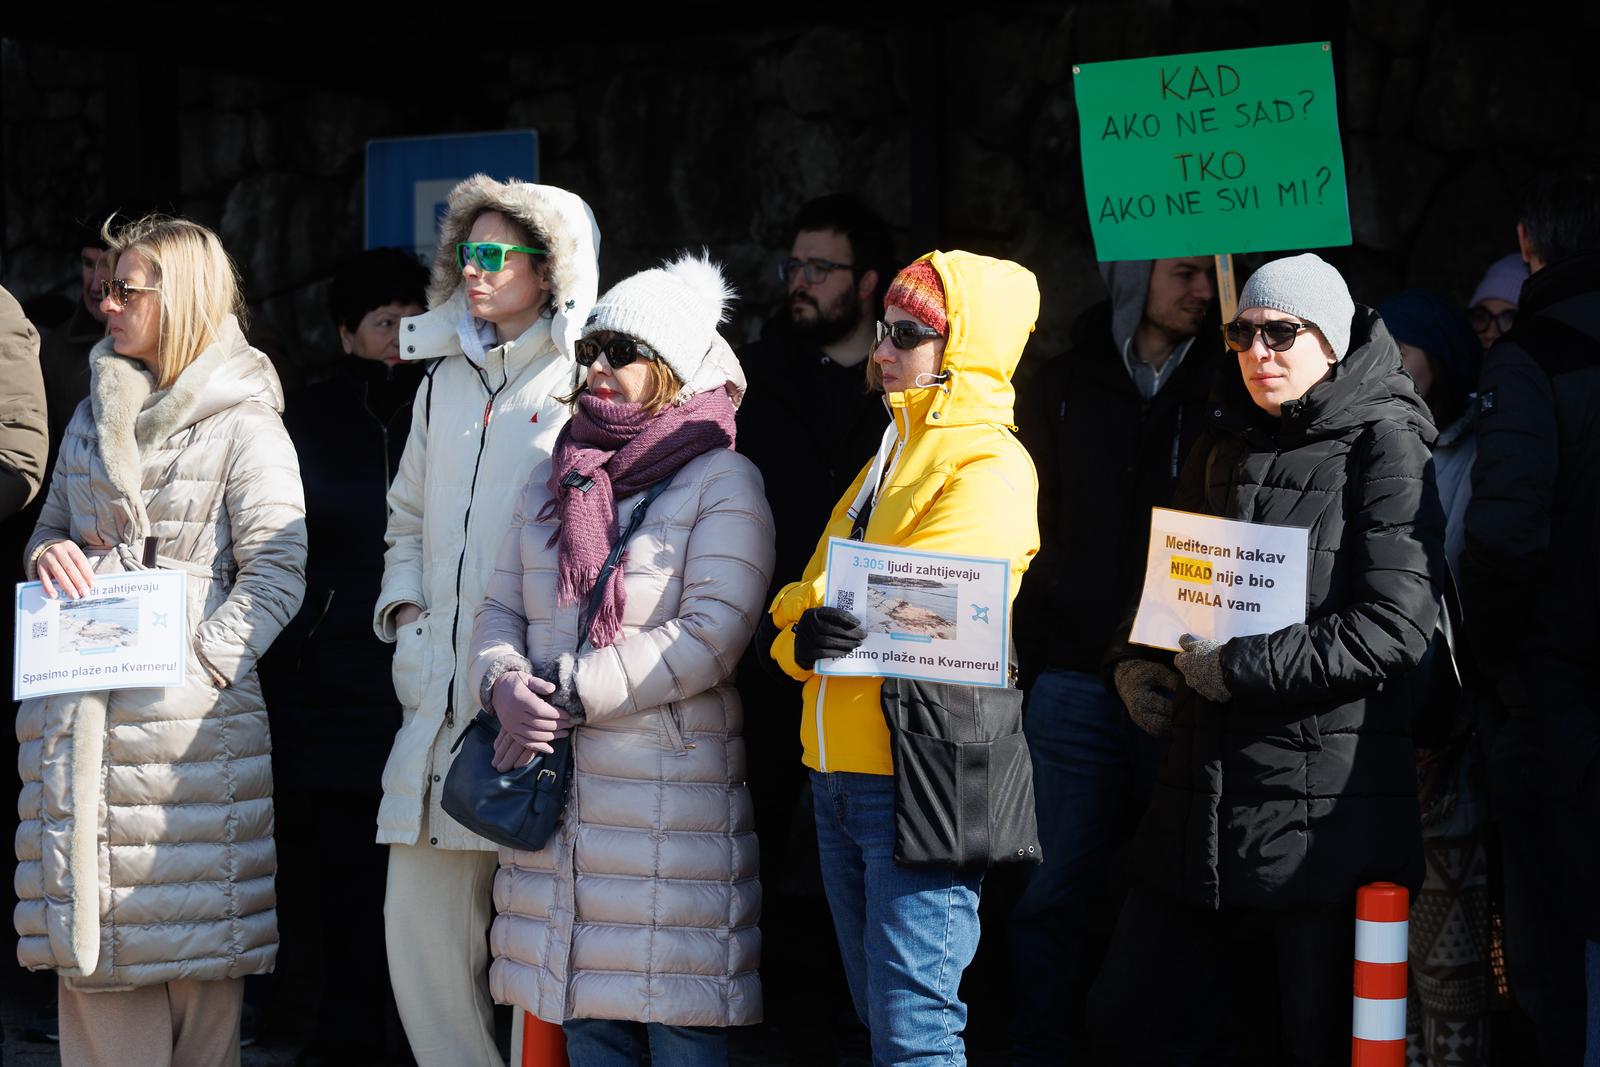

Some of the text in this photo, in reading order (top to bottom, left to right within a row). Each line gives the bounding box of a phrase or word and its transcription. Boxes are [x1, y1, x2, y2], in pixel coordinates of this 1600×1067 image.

[1159, 64, 1241, 101] KAD
[1101, 89, 1315, 141] AKO NE SAD?
[1173, 150, 1246, 182] TKO
[1098, 166, 1332, 224] AKO NE SVI MI?
[1165, 535, 1286, 564] Mediteran kakav
[852, 556, 981, 582] 3.305 ljudi zahtijevaju
[1170, 561, 1275, 589] NIKAD nije bio
[102, 583, 160, 598] zahtijevaju
[1177, 587, 1261, 613] HVALA vam
[22, 661, 178, 685] Spasimo plaže na Kvarneru!
[882, 649, 916, 664] plaže
[919, 655, 935, 666] na
[938, 656, 999, 672] Kvarneru!
